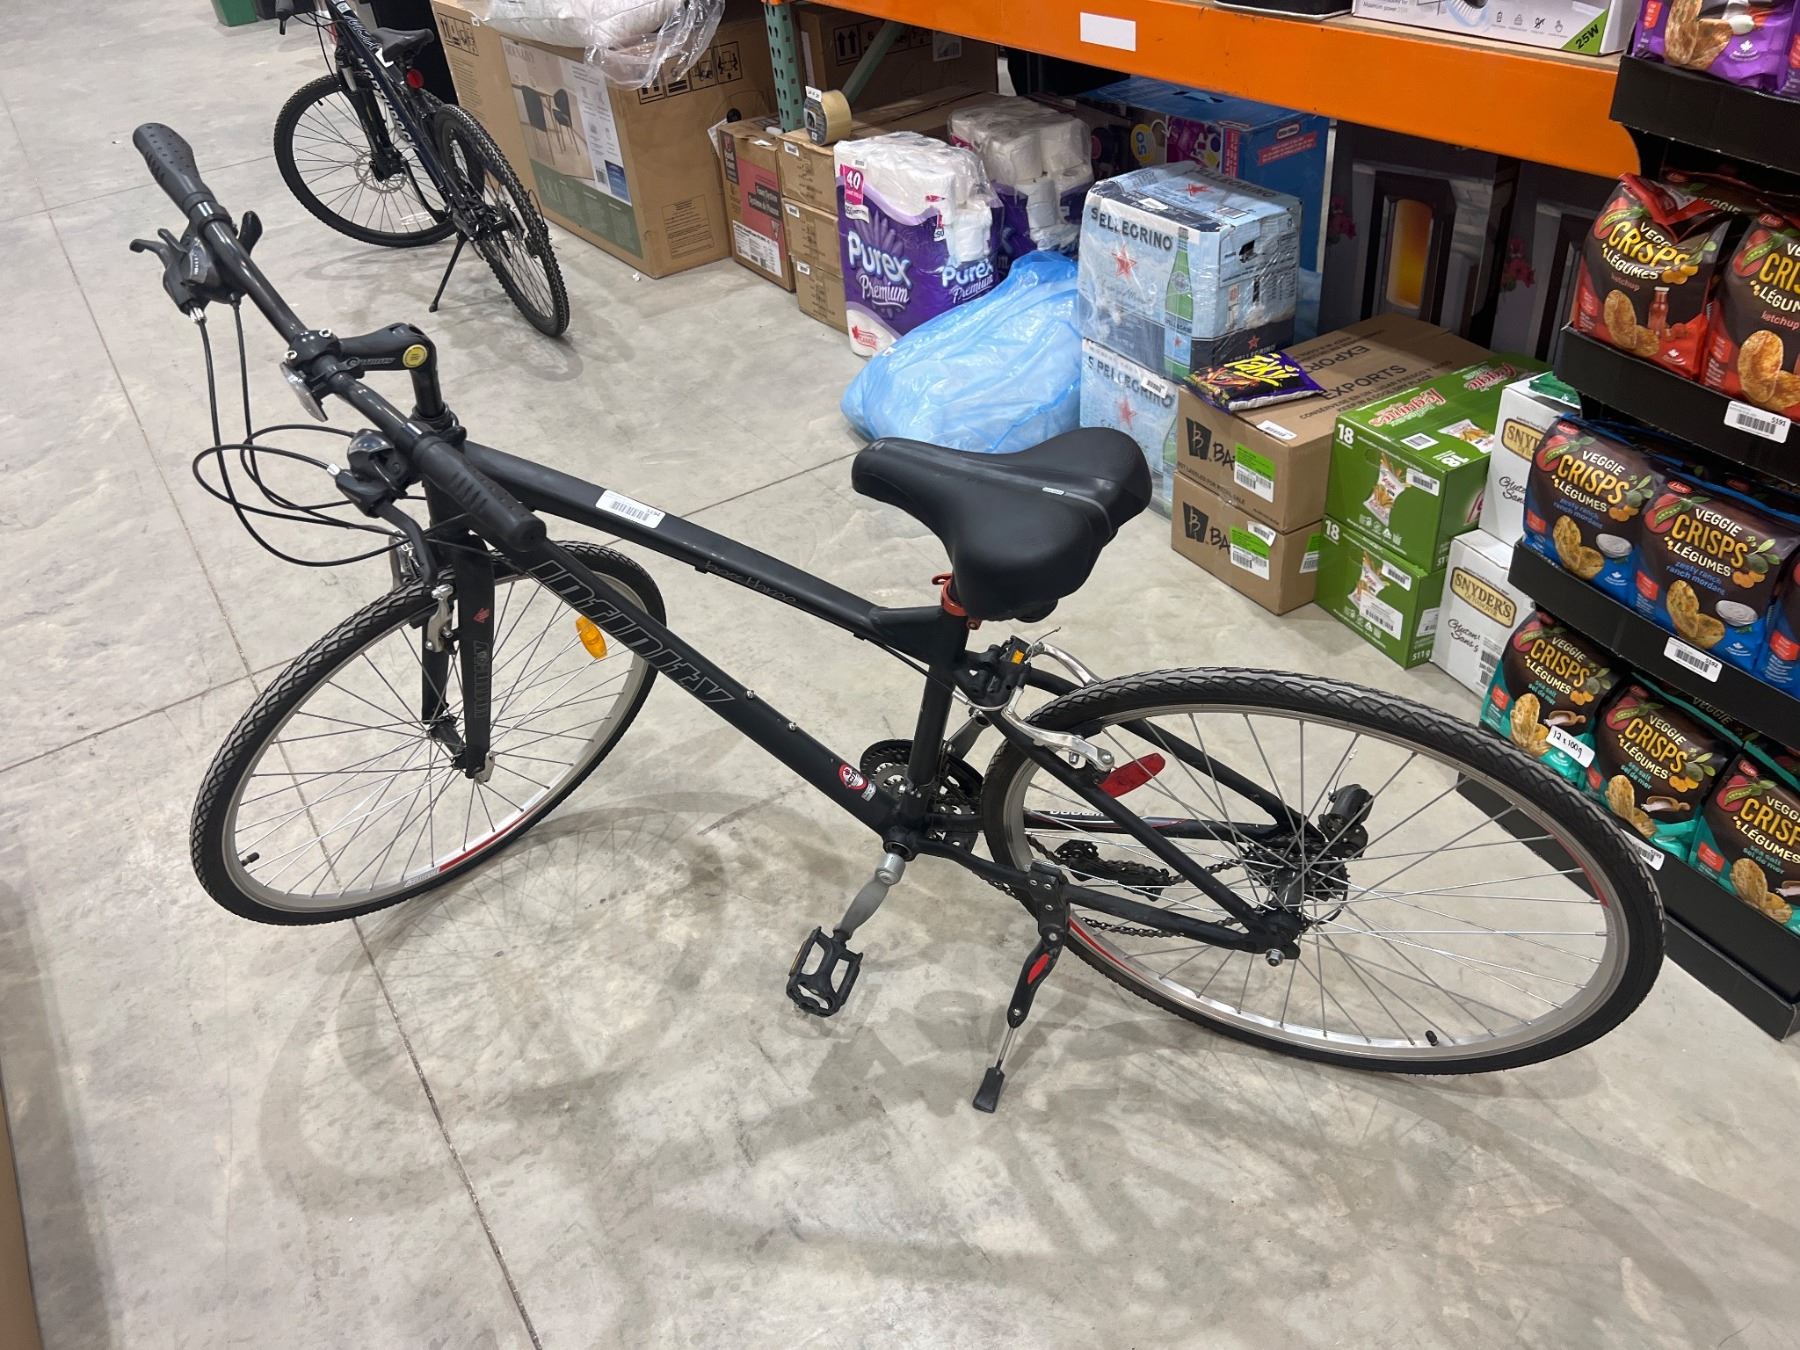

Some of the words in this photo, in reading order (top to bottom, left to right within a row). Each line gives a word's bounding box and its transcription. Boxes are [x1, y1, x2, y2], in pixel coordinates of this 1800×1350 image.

[1575, 24, 1600, 49] 25W
[846, 171, 861, 190] 40
[1699, 196, 1742, 214] EGGIE
[1640, 221, 1673, 249] VEGG
[847, 230, 912, 288] Purex
[942, 257, 994, 288] Purex
[1605, 249, 1659, 280] LÉGUMES
[858, 274, 910, 305] Premium
[950, 273, 994, 304] Premium
[1611, 272, 1641, 292] ketchup
[1761, 310, 1799, 332] ketchup
[1320, 365, 1407, 400] EXPORTS
[1338, 423, 1354, 444] 18
[1212, 443, 1237, 472] BA
[1441, 453, 1470, 467] 18
[1582, 450, 1627, 477] VEGGIE
[1557, 454, 1630, 505] CRISPS
[1558, 480, 1608, 513] LÉGUMES
[1325, 519, 1340, 541] 18
[1695, 508, 1743, 538] VEGGIE
[1671, 514, 1749, 569] CRISPS
[1666, 565, 1692, 579] ranch
[1672, 542, 1731, 577] LÉGUMES
[1675, 562, 1700, 573] zesty
[1455, 573, 1513, 619] SNYDER'S
[1530, 639, 1590, 687] CRISPS
[1552, 637, 1587, 662] VEGGIE
[1529, 661, 1571, 695] LÉGUMES
[1624, 717, 1689, 773] CRISPS
[1650, 715, 1687, 746] VEGGIE
[1623, 741, 1669, 780] LÉGUMES
